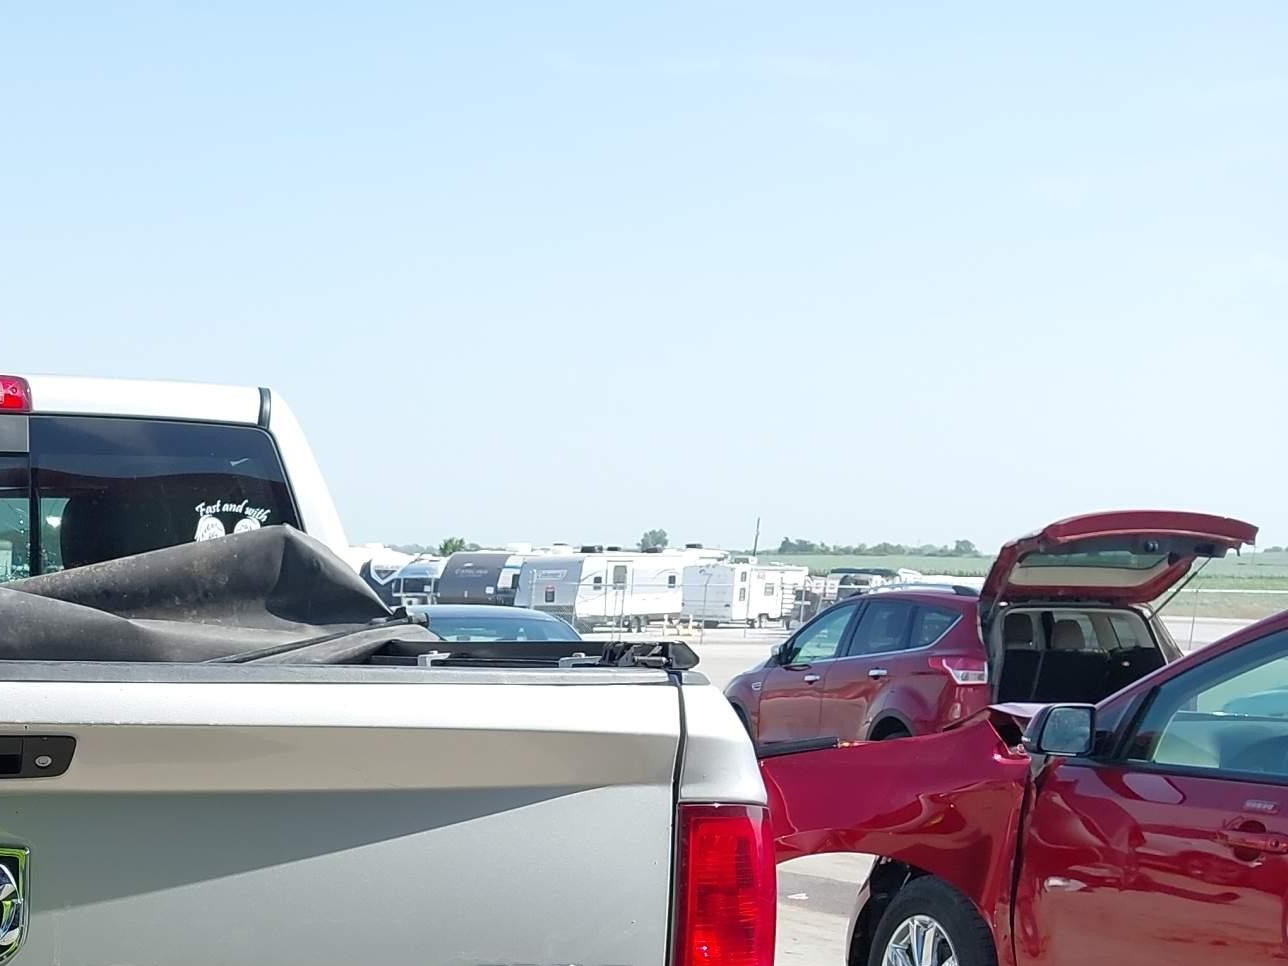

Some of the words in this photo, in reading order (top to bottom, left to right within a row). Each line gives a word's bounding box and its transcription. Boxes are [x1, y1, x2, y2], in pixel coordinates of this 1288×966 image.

[195, 500, 221, 516] Fast
[222, 500, 248, 514] and
[244, 507, 271, 522] with
